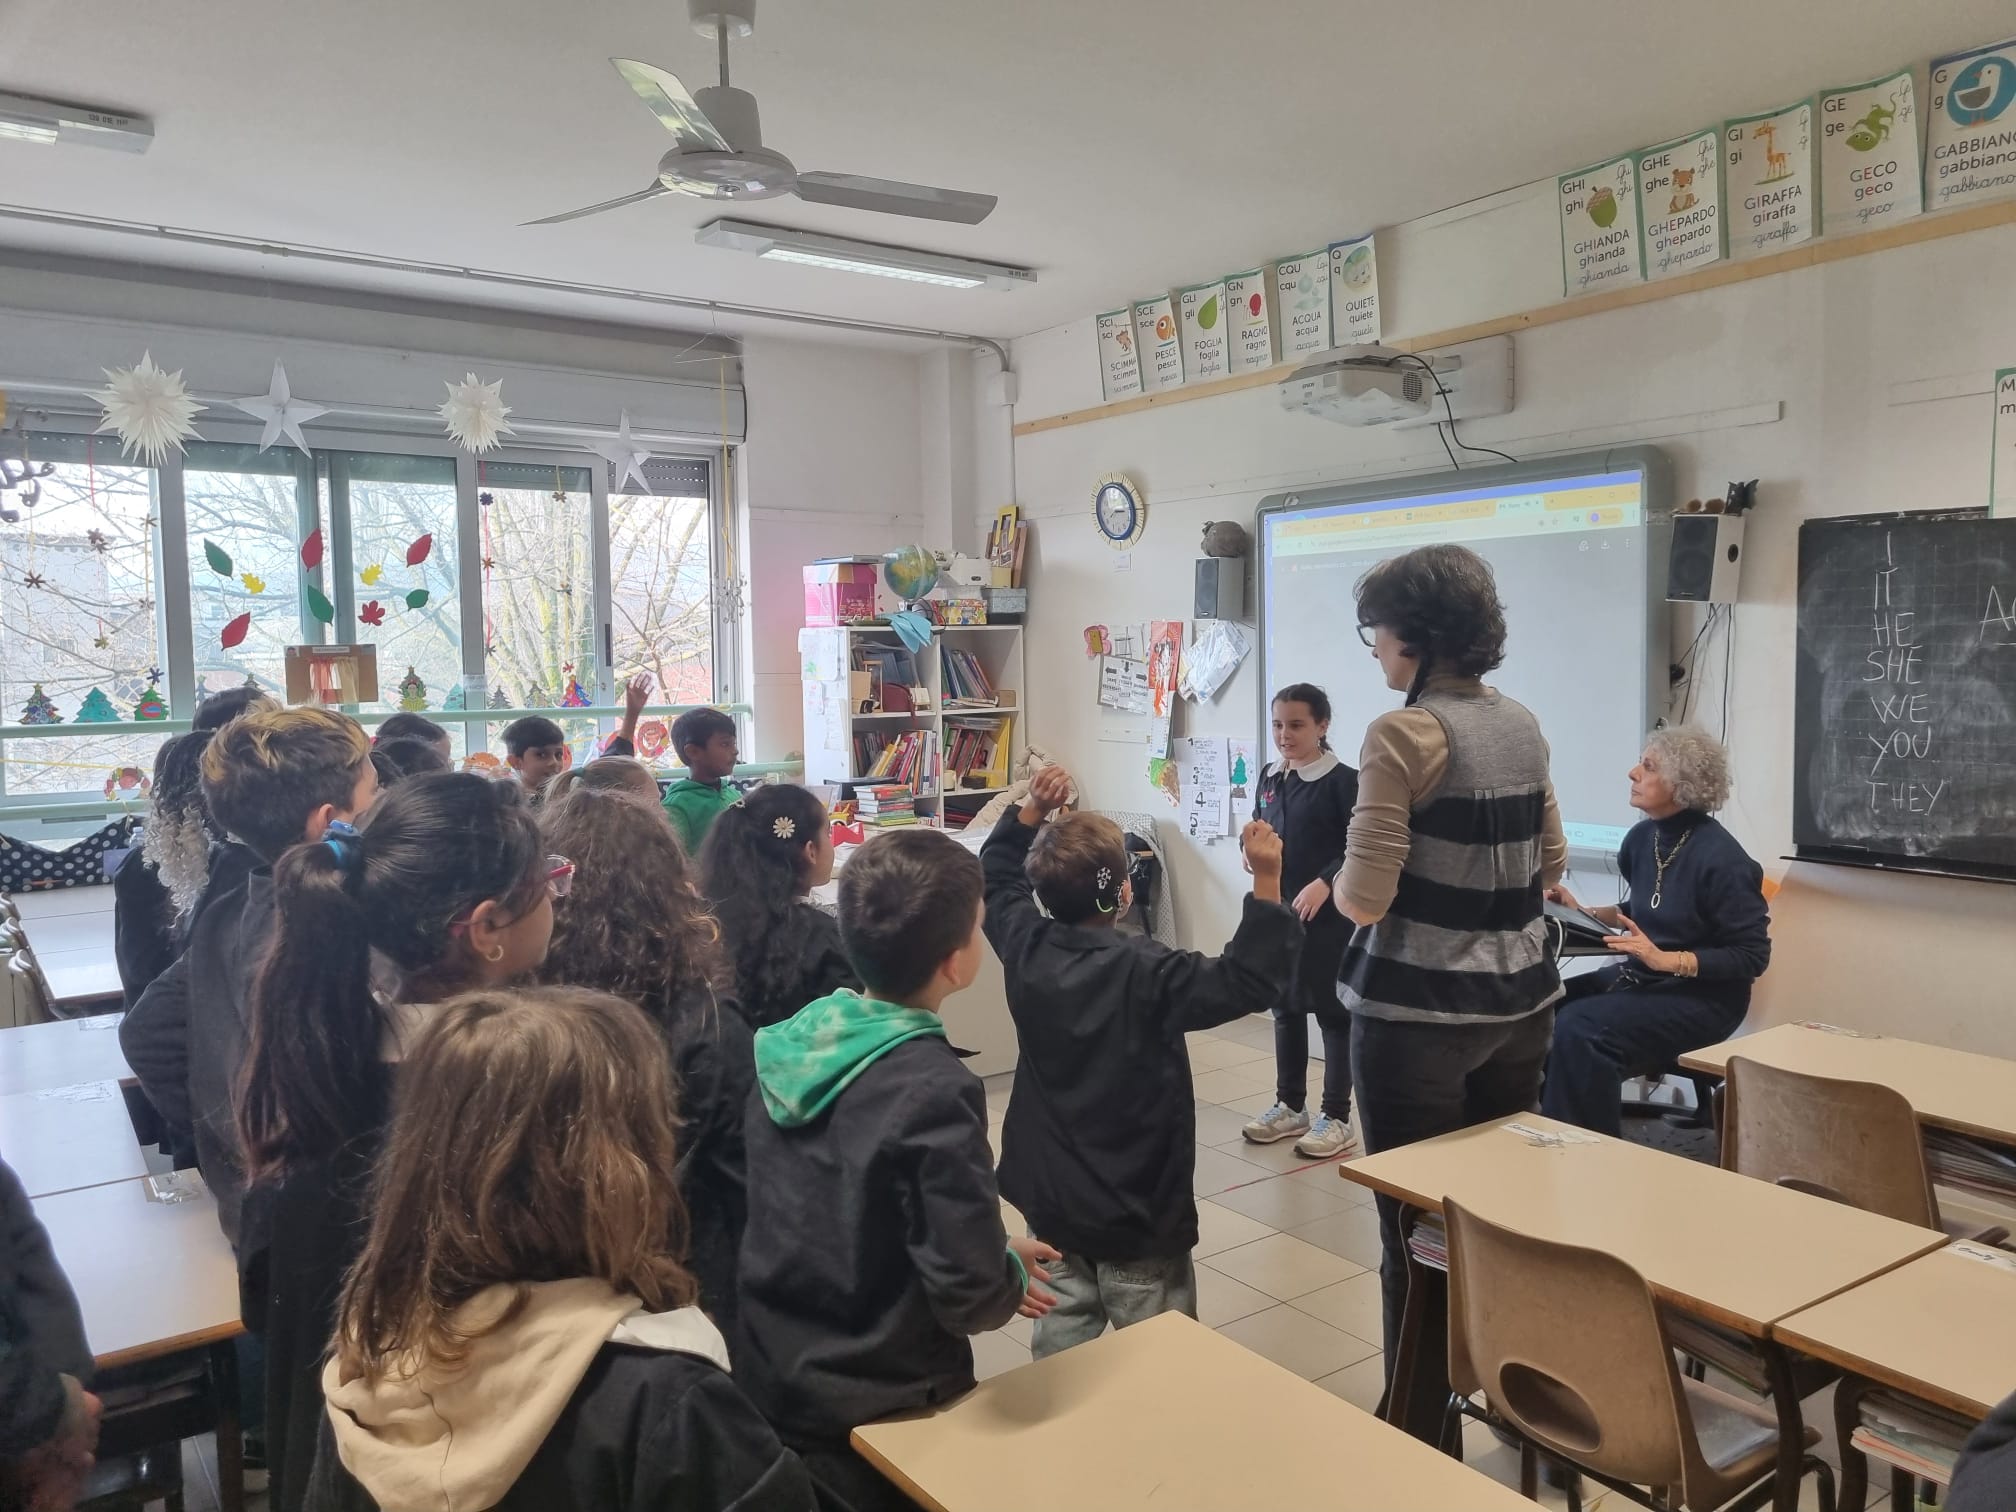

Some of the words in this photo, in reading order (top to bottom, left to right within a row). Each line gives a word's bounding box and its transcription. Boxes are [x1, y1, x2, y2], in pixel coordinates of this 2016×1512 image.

[1934, 69, 1947, 83] G
[1824, 98, 1846, 112] GE
[1934, 96, 1943, 109] g
[1728, 128, 1743, 142] GI
[1825, 122, 1844, 136] ge
[1642, 154, 1671, 172] GHE
[1730, 148, 1742, 165] gi
[1940, 151, 2016, 178] gabbiano
[1850, 161, 1897, 182] GECO
[1562, 179, 1584, 194] GHI
[1645, 177, 1670, 193] ghe
[1854, 181, 1893, 201] geco
[1938, 174, 2016, 202] gabbiano
[1744, 184, 1802, 210] GIRAFFA
[1566, 200, 1584, 214] ghi
[1856, 202, 1894, 224] geco
[1648, 205, 1716, 236] GHEPARDO
[1752, 204, 1796, 227] giraffa
[1574, 229, 1630, 254] GHIANDA
[1656, 224, 1712, 252] ghepardo
[1752, 220, 1799, 248] giraffa
[1332, 250, 1341, 260] Q
[1579, 246, 1626, 269] ghianda
[1658, 240, 1713, 271] ghepardo
[1278, 264, 1301, 276] CQU
[1334, 266, 1340, 276] q
[1578, 263, 1630, 288] ghianda
[1228, 282, 1244, 291] GN
[1280, 281, 1296, 292] cqu
[1182, 294, 1196, 304] GLI
[1230, 296, 1242, 306] gn
[1346, 296, 1374, 312] QUIETE
[1137, 306, 1155, 316] SCE
[1184, 309, 1194, 320] gli
[1292, 312, 1321, 326] ACQUA
[1349, 310, 1374, 326] quiete
[1100, 318, 1113, 328] SCI
[1140, 320, 1154, 328] sce
[1296, 325, 1318, 337] acqua
[1102, 330, 1112, 340] sci
[1242, 326, 1268, 340] RAGNO
[1194, 337, 1222, 350] FOGLIA
[1246, 340, 1266, 351] ragno
[1156, 346, 1176, 360] PESCE
[1200, 350, 1220, 361] foglia
[1158, 360, 1176, 372] pesce
[1886, 531, 1892, 566] I
[1874, 567, 1899, 611] IT
[1873, 612, 1916, 647] HE
[1863, 645, 1922, 684] SHE
[1870, 694, 1928, 724] WE
[1868, 726, 1932, 777] YOU
[1195, 792, 1206, 808] 4
[1864, 779, 1944, 816] THEY
[1190, 812, 1198, 828] 5
